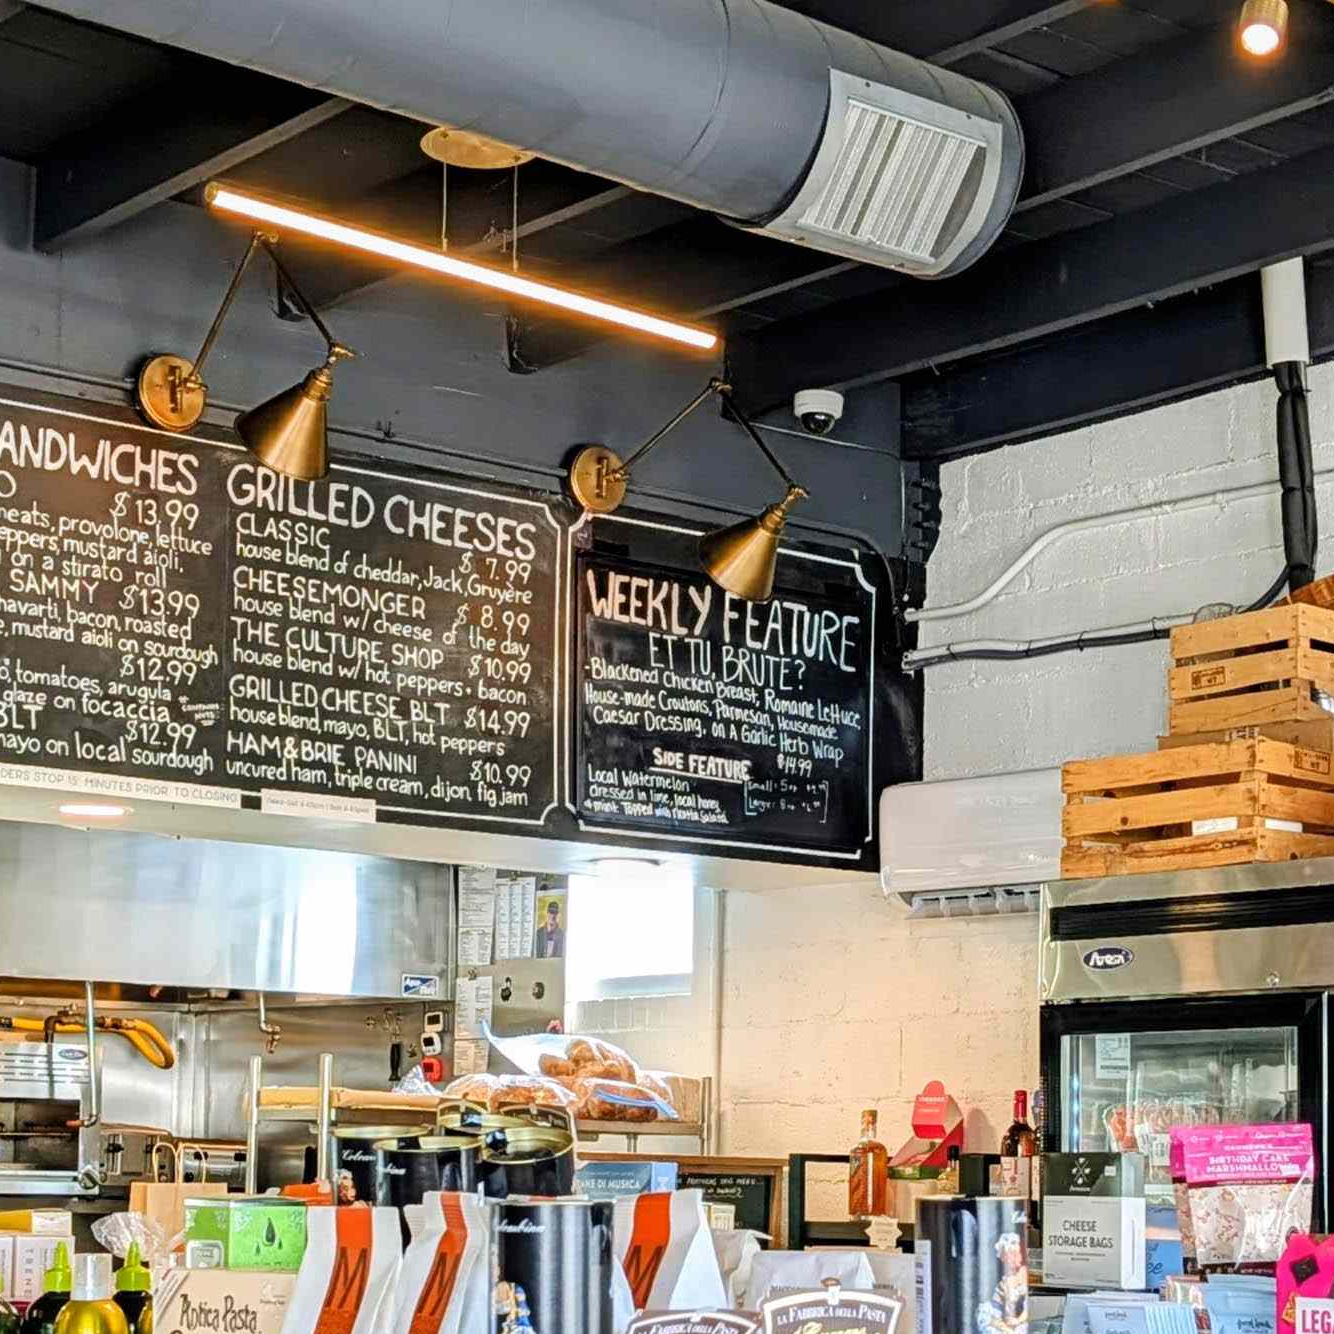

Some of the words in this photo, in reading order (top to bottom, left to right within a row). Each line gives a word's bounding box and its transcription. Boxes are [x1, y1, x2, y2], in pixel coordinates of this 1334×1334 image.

[228, 463, 375, 530] GRILLED
[383, 495, 536, 561] CHEESES
[156, 525, 213, 556] lettuce
[236, 512, 331, 550] CLASSIC
[63, 538, 138, 565] mustard
[286, 541, 329, 572] blend
[9, 569, 99, 603] SAMMY
[62, 554, 122, 582] stirato
[136, 565, 166, 588] roll
[233, 565, 426, 619] CHEESEMONGER
[124, 614, 192, 640] roasted
[233, 587, 282, 617] house
[289, 598, 335, 626] blend
[374, 613, 432, 642] cheese
[500, 633, 530, 660] day
[587, 569, 712, 636] WEEKLY
[723, 593, 859, 671] FEATURE
[11, 621, 74, 643] mustard
[143, 637, 218, 669] sourdough
[230, 616, 280, 647] THE
[285, 626, 386, 665] CULTURE
[391, 644, 444, 670] SHOP
[233, 638, 282, 668] house
[286, 647, 333, 675] blend
[366, 662, 391, 684] hot
[397, 670, 463, 696] peppers
[478, 678, 527, 705] bacon
[649, 633, 679, 668] ET
[722, 646, 806, 690] BRUTE?
[3, 685, 47, 708] glaze
[81, 687, 169, 724] focaccia
[108, 674, 172, 703] arugula
[229, 673, 317, 707] GRILLED
[322, 687, 402, 720] CHEESE
[410, 698, 450, 725] BLT
[766, 689, 814, 720] Romaine
[75, 731, 125, 762] local
[132, 741, 214, 775] sourdough
[412, 726, 436, 745] hot
[440, 734, 505, 757] peppers
[226, 757, 287, 780] uncured
[334, 762, 373, 791] triple
[354, 751, 417, 774] PANINI
[653, 747, 684, 770] SIDE
[689, 751, 752, 780] FEATURE
[1047, 1233, 1089, 1250] STORAGE
[1090, 1234, 1114, 1250] BAGS
[1061, 1218, 1098, 1234] CHEESE
[179, 1293, 221, 1331] Antica
[222, 1295, 259, 1334] Pasta
